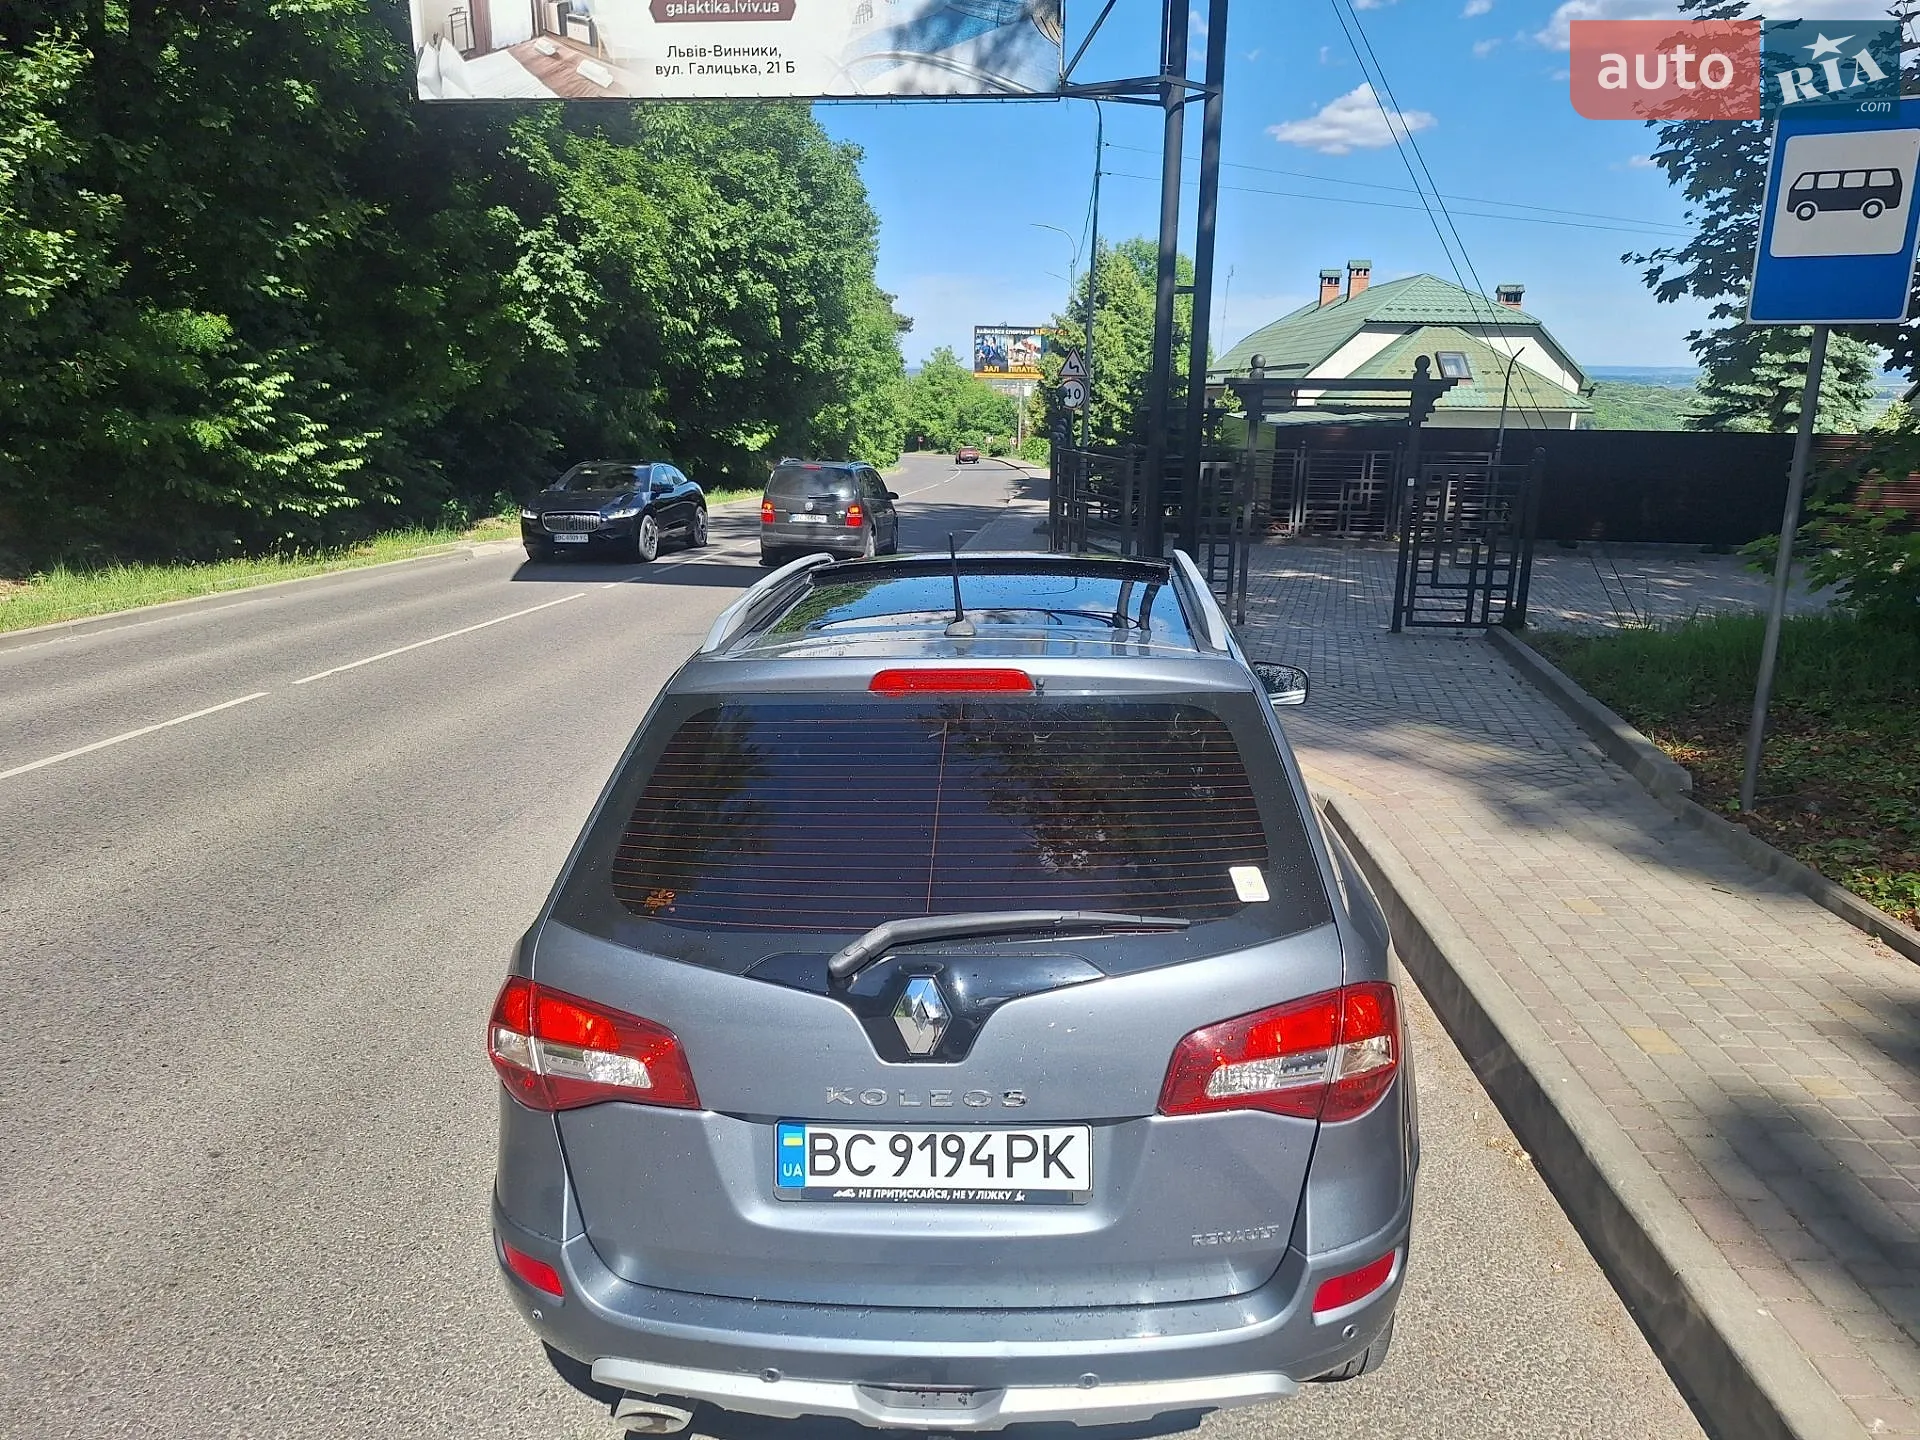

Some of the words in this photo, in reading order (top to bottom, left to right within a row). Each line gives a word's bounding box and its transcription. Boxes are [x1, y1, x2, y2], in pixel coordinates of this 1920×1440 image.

[666, 0, 780, 16] galaktika.lviv.ua
[666, 45, 782, 58] Львів-Винники,
[655, 65, 684, 77] вул.
[689, 62, 762, 75] Галицька,
[766, 62, 780, 74] 21
[786, 61, 795, 73] Б
[983, 365, 1000, 373] ЗАЛ
[825, 1086, 1028, 1108] KOLEOS
[889, 1133, 995, 1178] 9194
[783, 1163, 803, 1178] UA
[858, 1189, 872, 1198] НЕ
[873, 1188, 951, 1200] ПРИТИСКАЙСЯ,
[952, 1190, 966, 1199] НЕ
[967, 1190, 977, 1200] У
[976, 1190, 1012, 1200] ЛІЖКУ
[1191, 1225, 1279, 1247] RENAULT
